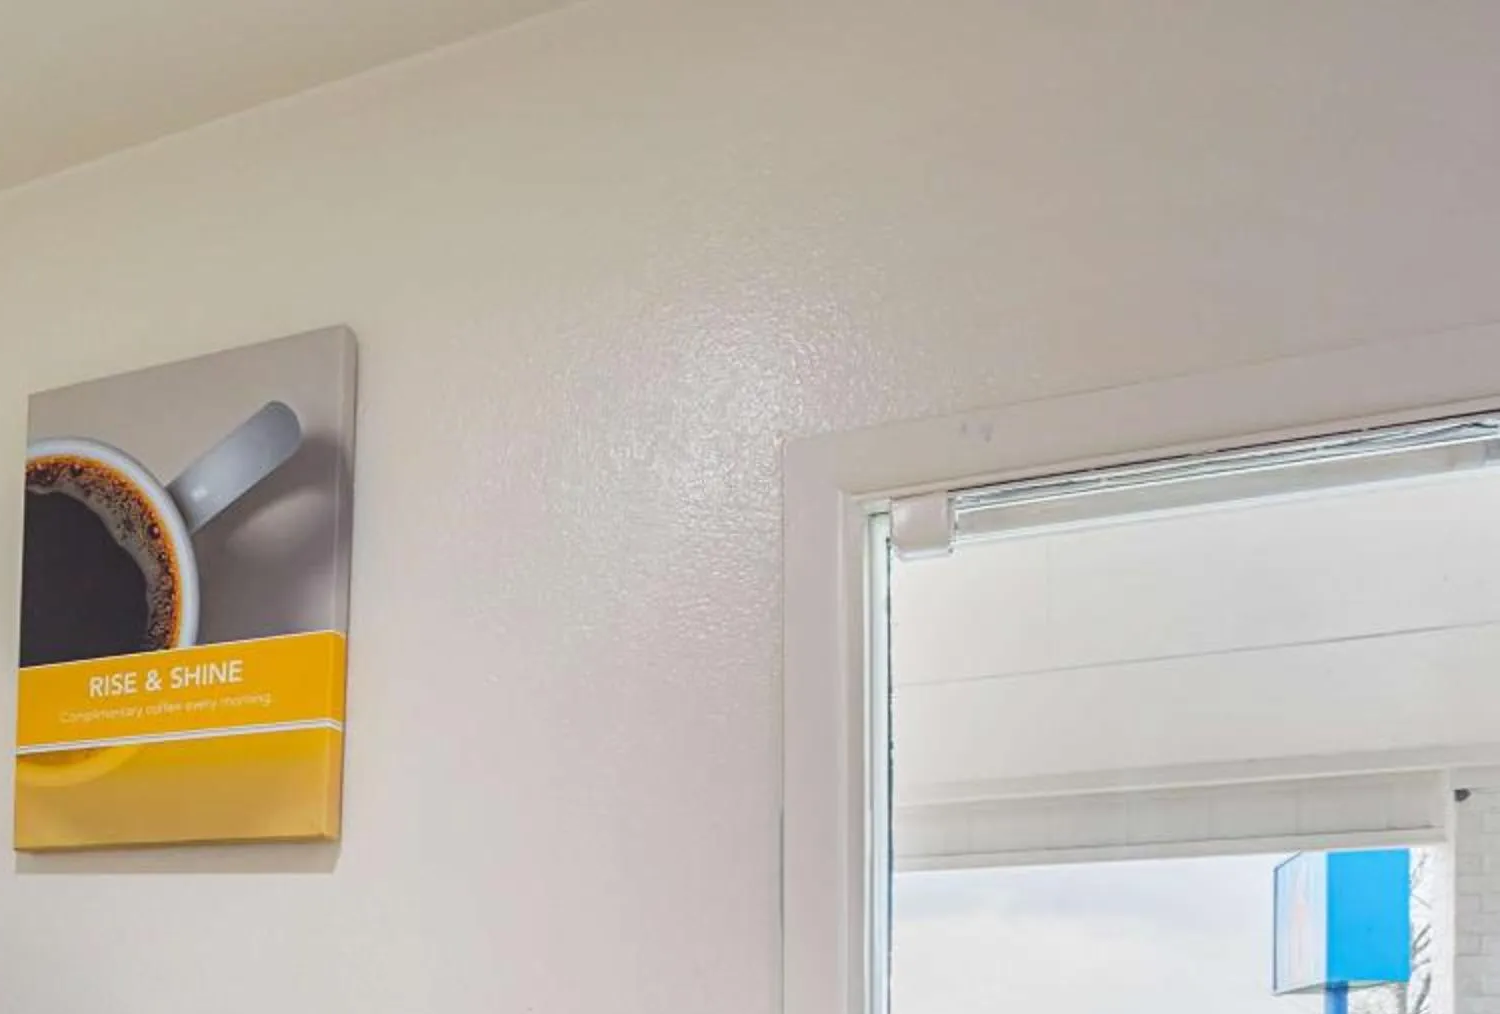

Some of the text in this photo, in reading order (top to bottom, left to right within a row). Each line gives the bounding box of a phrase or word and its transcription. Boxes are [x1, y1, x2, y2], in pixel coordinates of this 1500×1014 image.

[89, 660, 243, 697] RISE & SHINE
[145, 700, 181, 715] coffee
[185, 698, 217, 713] every
